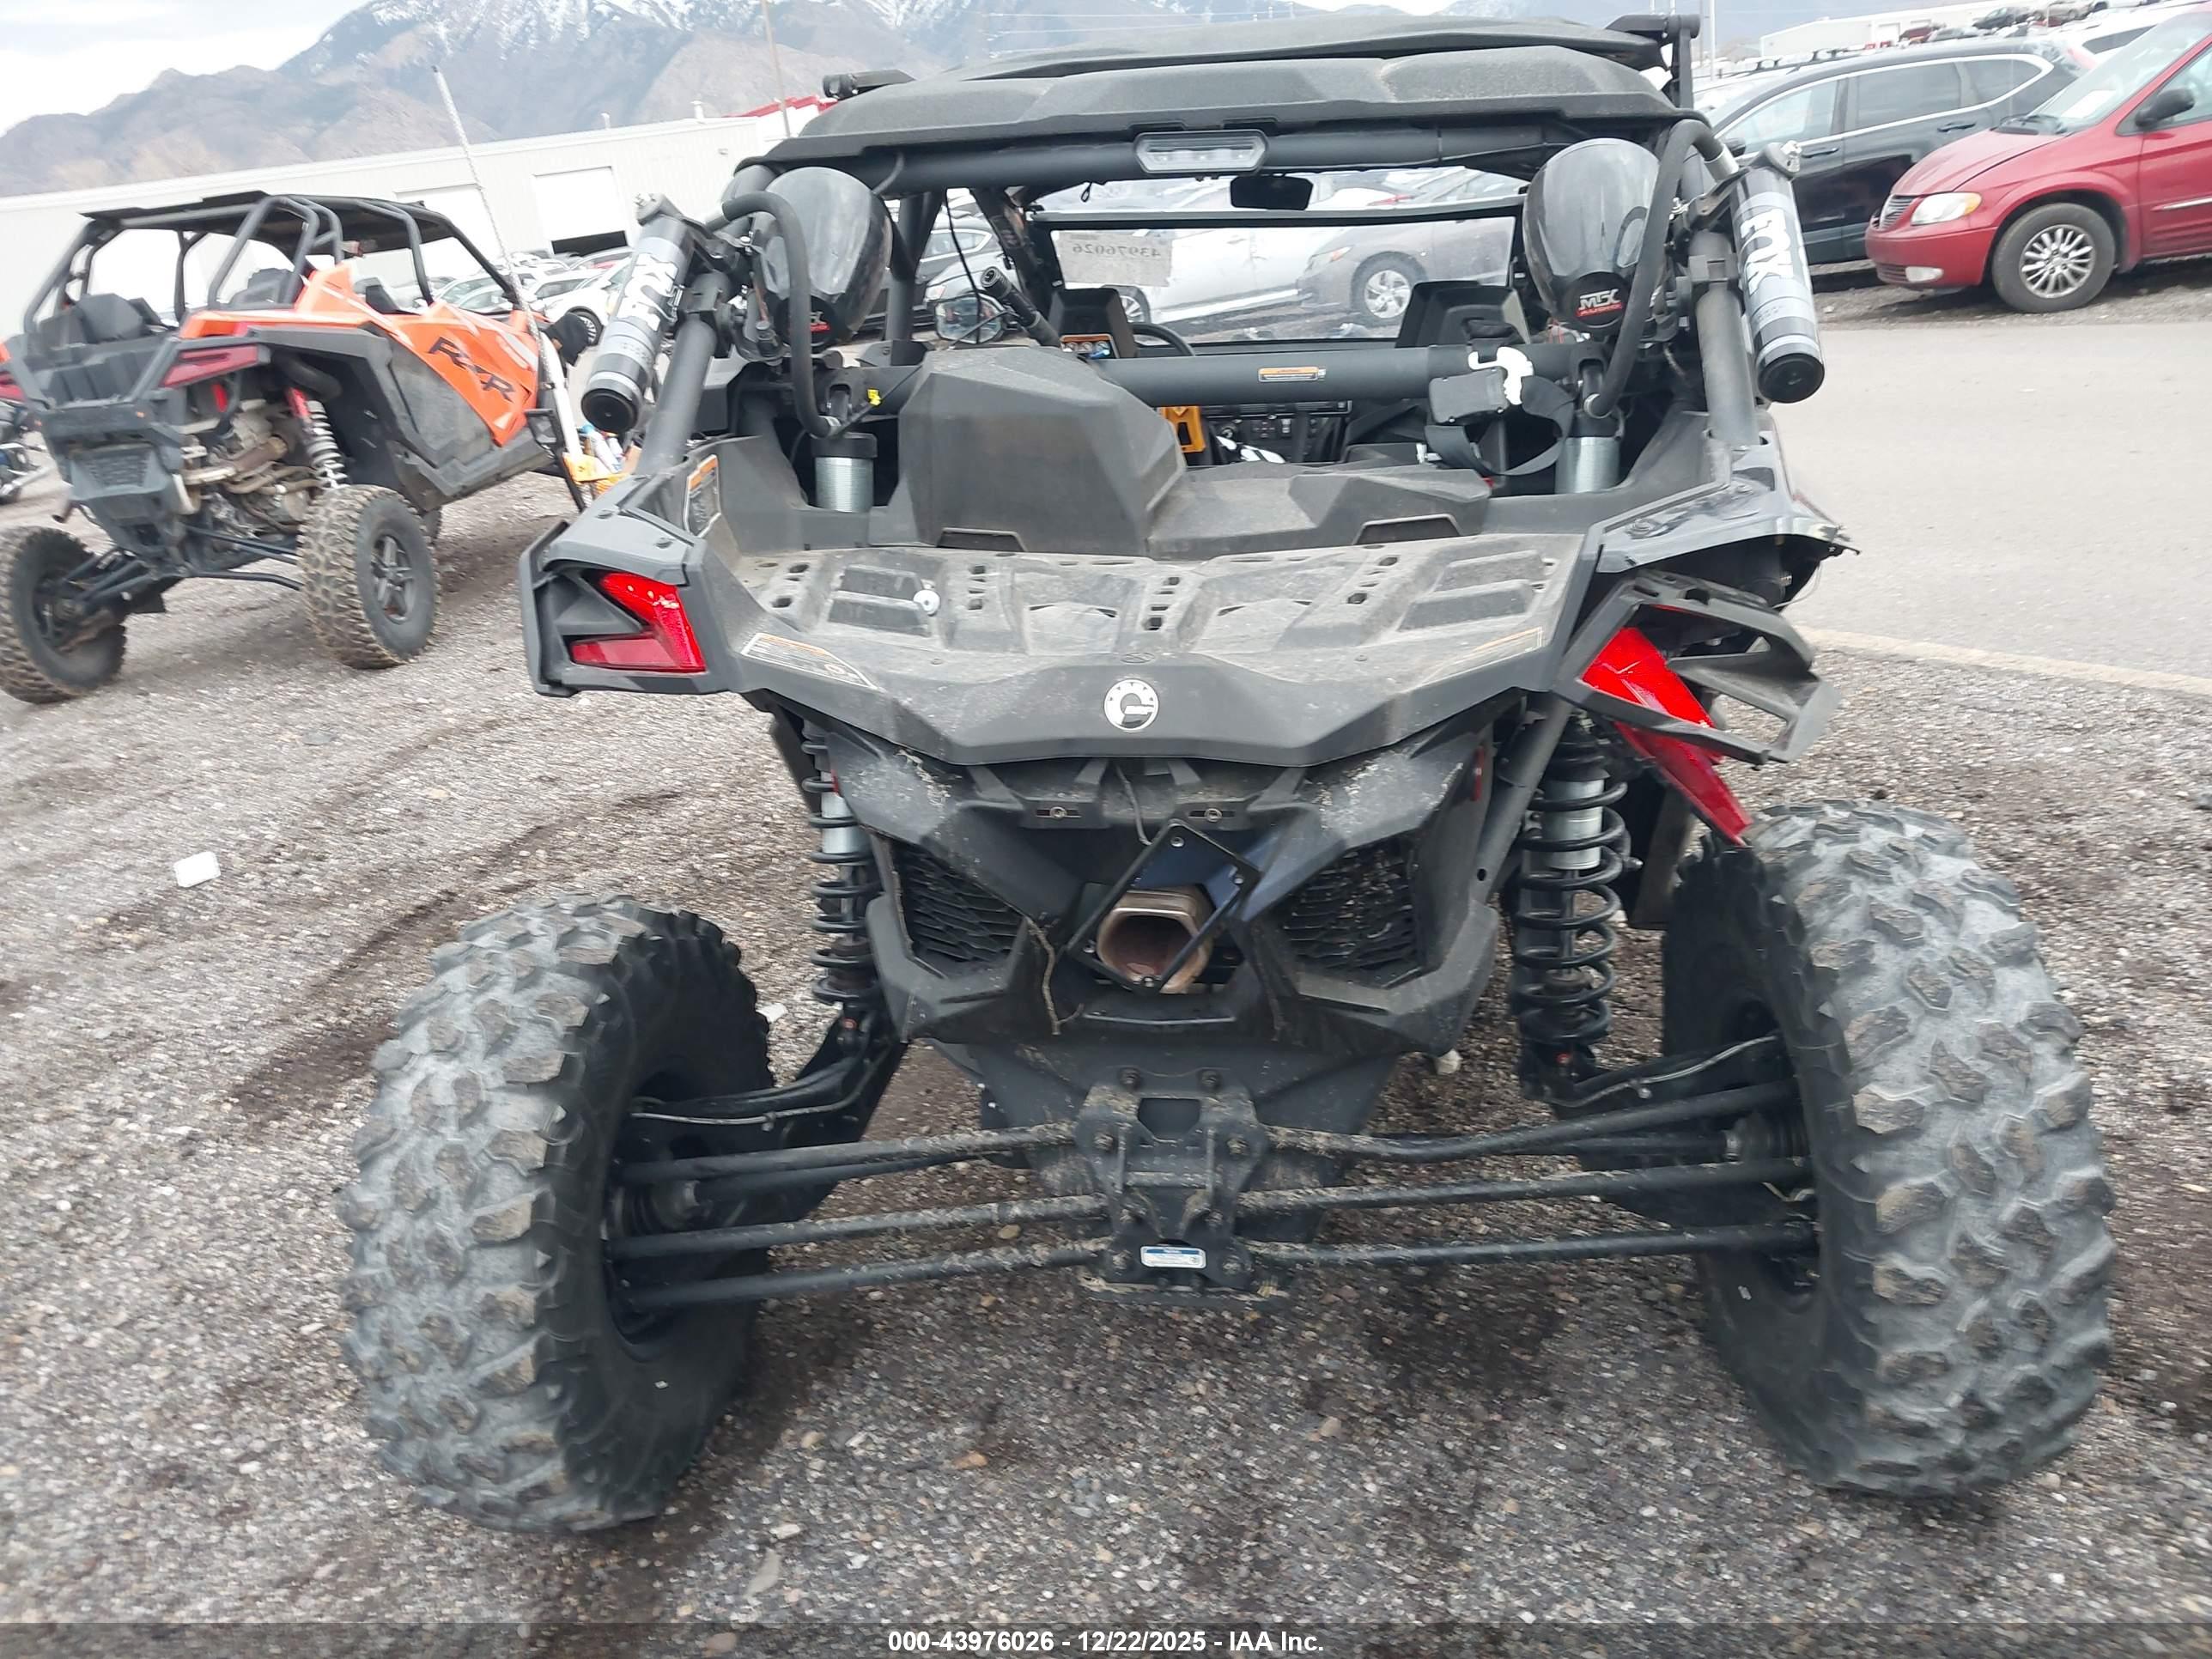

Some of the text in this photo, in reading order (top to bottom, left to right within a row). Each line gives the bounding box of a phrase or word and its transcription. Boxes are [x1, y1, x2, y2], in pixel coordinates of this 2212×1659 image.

[1740, 208, 1794, 296] FOX
[617, 252, 678, 332] FOX
[1578, 289, 1621, 311] MTX
[428, 336, 515, 404] RZR
